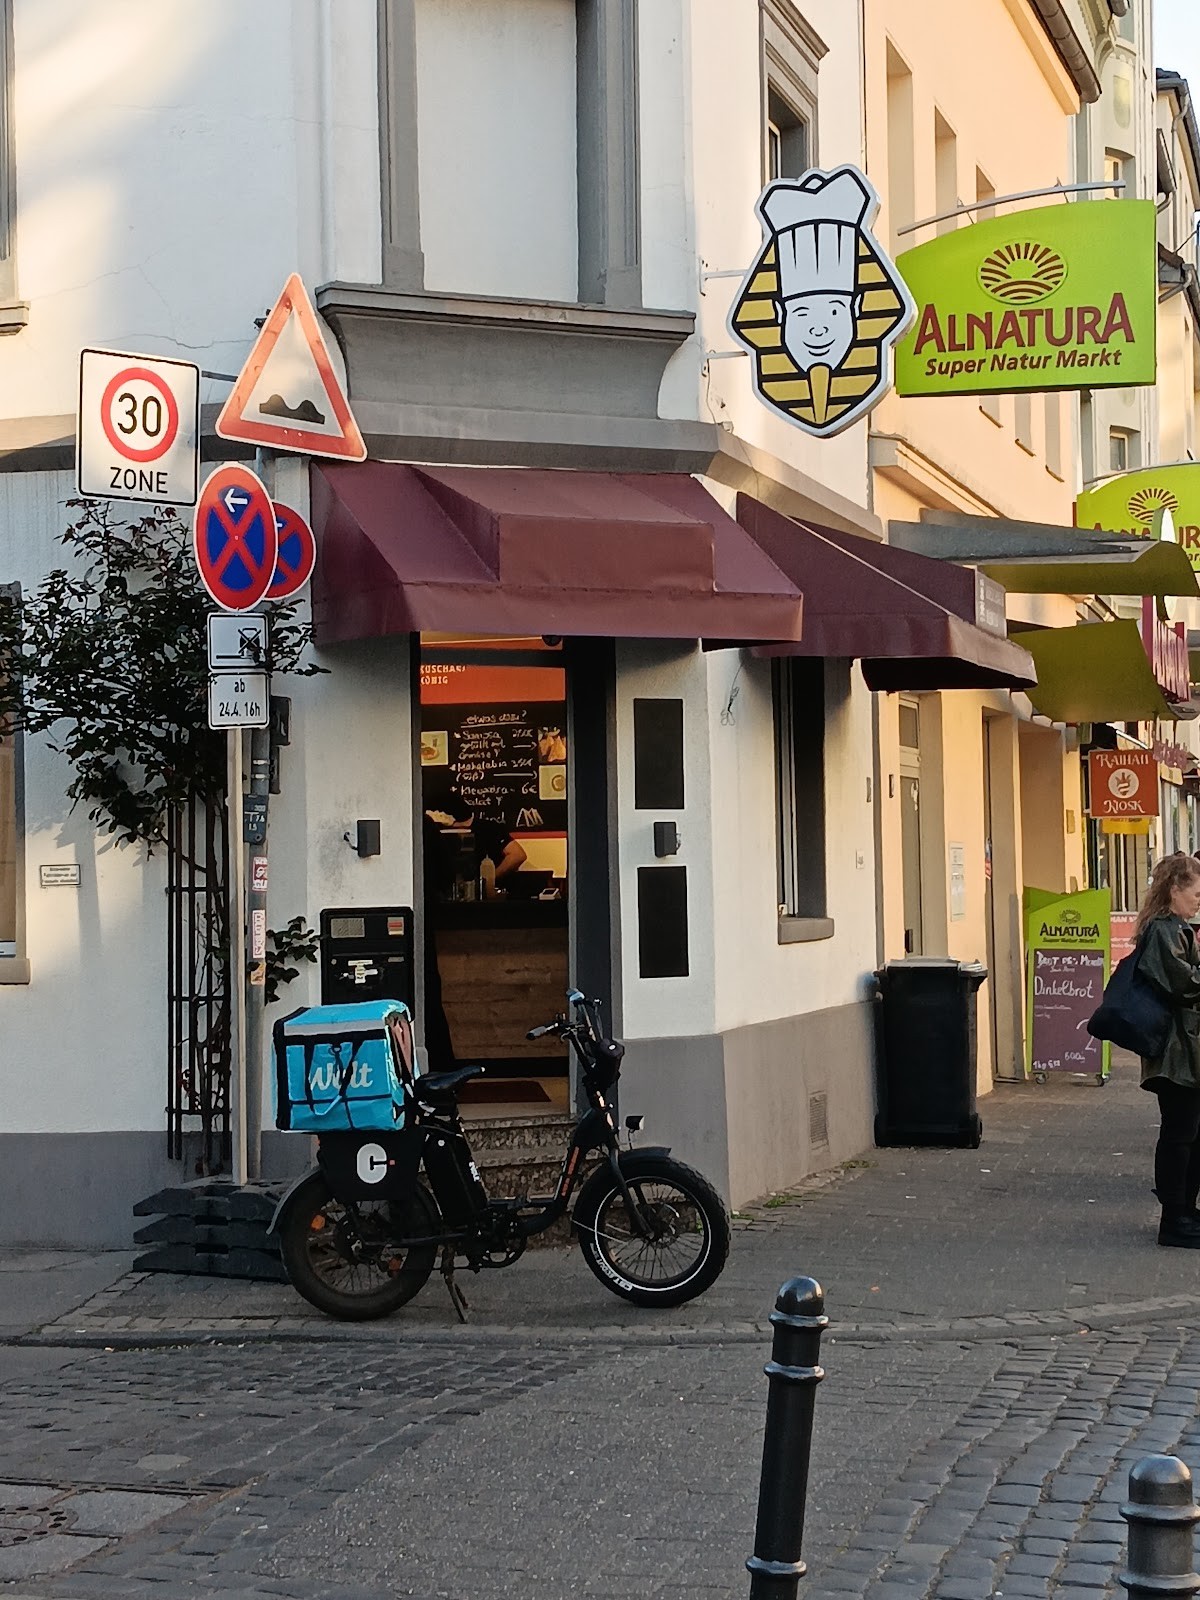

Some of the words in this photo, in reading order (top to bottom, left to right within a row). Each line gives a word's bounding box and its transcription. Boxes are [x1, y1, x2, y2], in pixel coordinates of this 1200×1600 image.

[913, 292, 1134, 355] ALNATURA
[925, 355, 986, 379] Super
[990, 350, 1052, 372] Natur
[1056, 347, 1122, 369] Markt
[117, 392, 162, 438] 30
[109, 466, 169, 495] ZONE
[234, 678, 245, 692] ab
[219, 701, 241, 717] 24.4.
[244, 701, 260, 716] 16h
[521, 781, 538, 794] 6€
[1103, 799, 1146, 814] KIOSK
[1040, 921, 1099, 938] ALNATURA
[1034, 975, 1095, 999] Dinkelbrot
